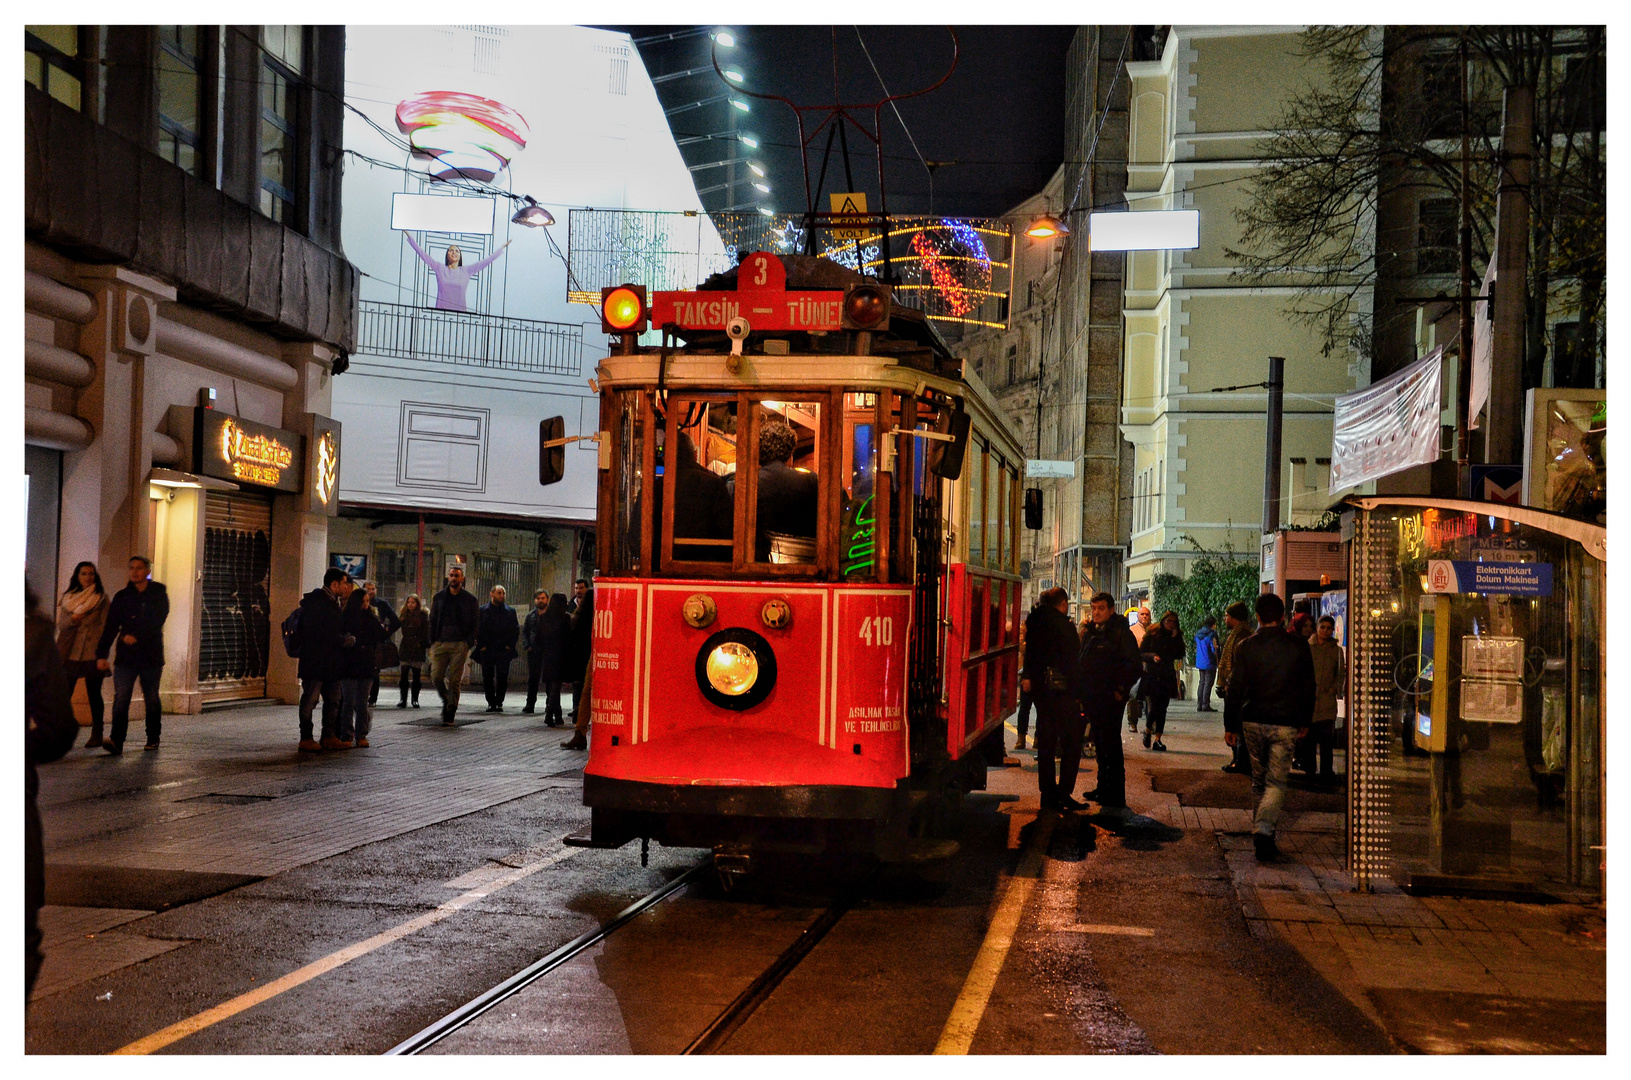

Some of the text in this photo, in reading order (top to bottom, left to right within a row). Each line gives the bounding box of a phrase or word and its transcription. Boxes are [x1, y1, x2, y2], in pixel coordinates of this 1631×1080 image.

[839, 230, 864, 238] VOLT
[754, 257, 768, 285] 3
[1479, 537, 1529, 549] METRO
[1476, 566, 1532, 575] Elektronikkart
[1476, 575, 1539, 584] Dolum Makinesi
[859, 616, 893, 646] 410
[597, 660, 606, 669] ALO
[844, 721, 857, 733] VE
